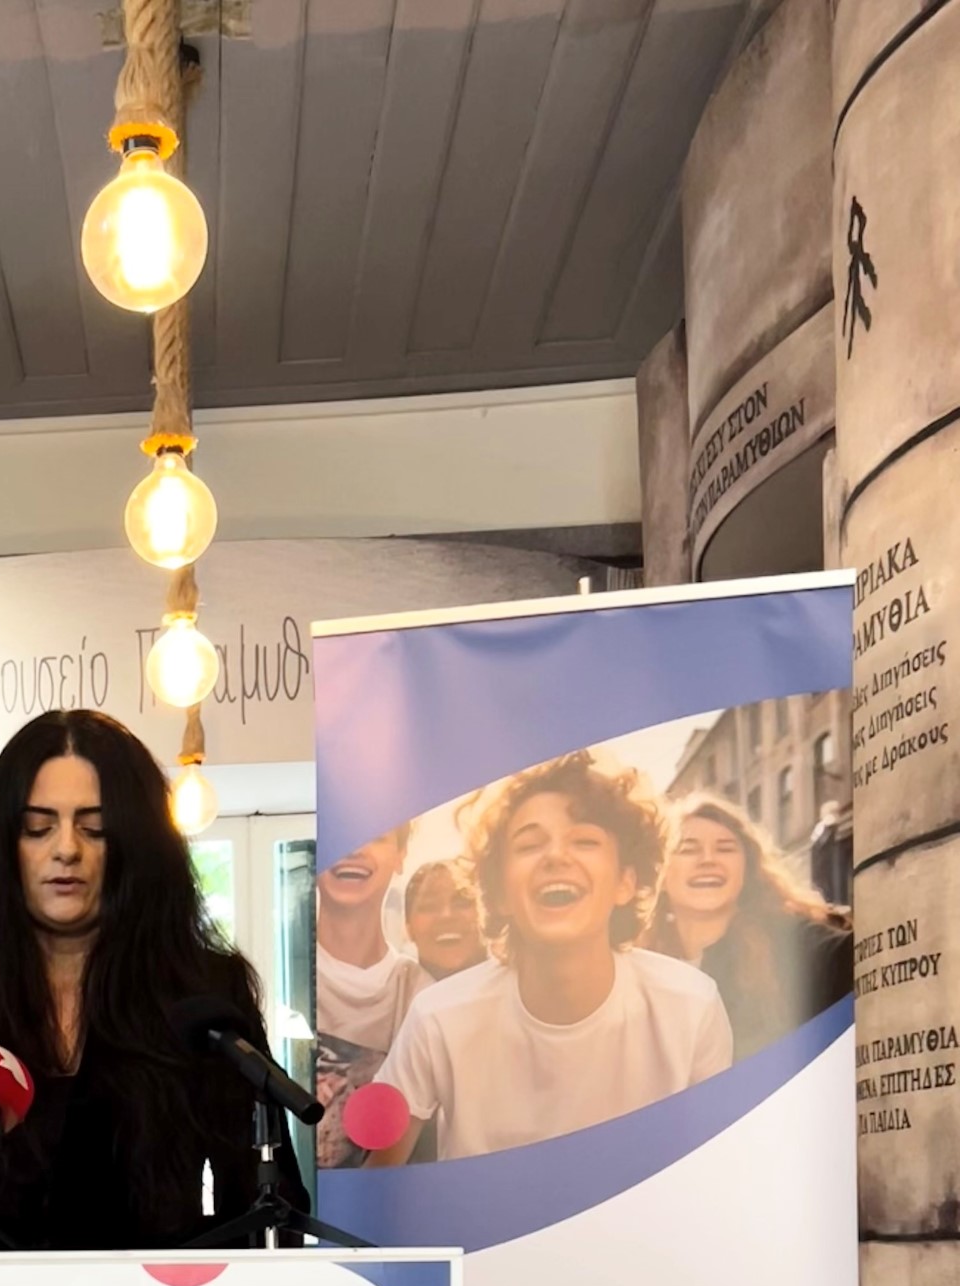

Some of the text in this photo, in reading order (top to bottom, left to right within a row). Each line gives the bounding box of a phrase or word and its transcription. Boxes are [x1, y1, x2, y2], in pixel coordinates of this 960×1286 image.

[727, 381, 769, 443] ΣΤΟΝ
[708, 396, 806, 512] ΠΑΡΑΜΥΘΙΩΝ
[881, 722, 949, 772] Δράκους
[888, 918, 918, 949] ΤΩΝ
[881, 952, 942, 988] ΚΥΠΡΟΥ
[872, 1025, 959, 1063] ΠΑΡΑΜΥΘΙΑ
[880, 1062, 957, 1097] ΕΠΙΤΗΔΕΣ
[870, 1107, 912, 1134] ΠΑΙΔΙΑ
